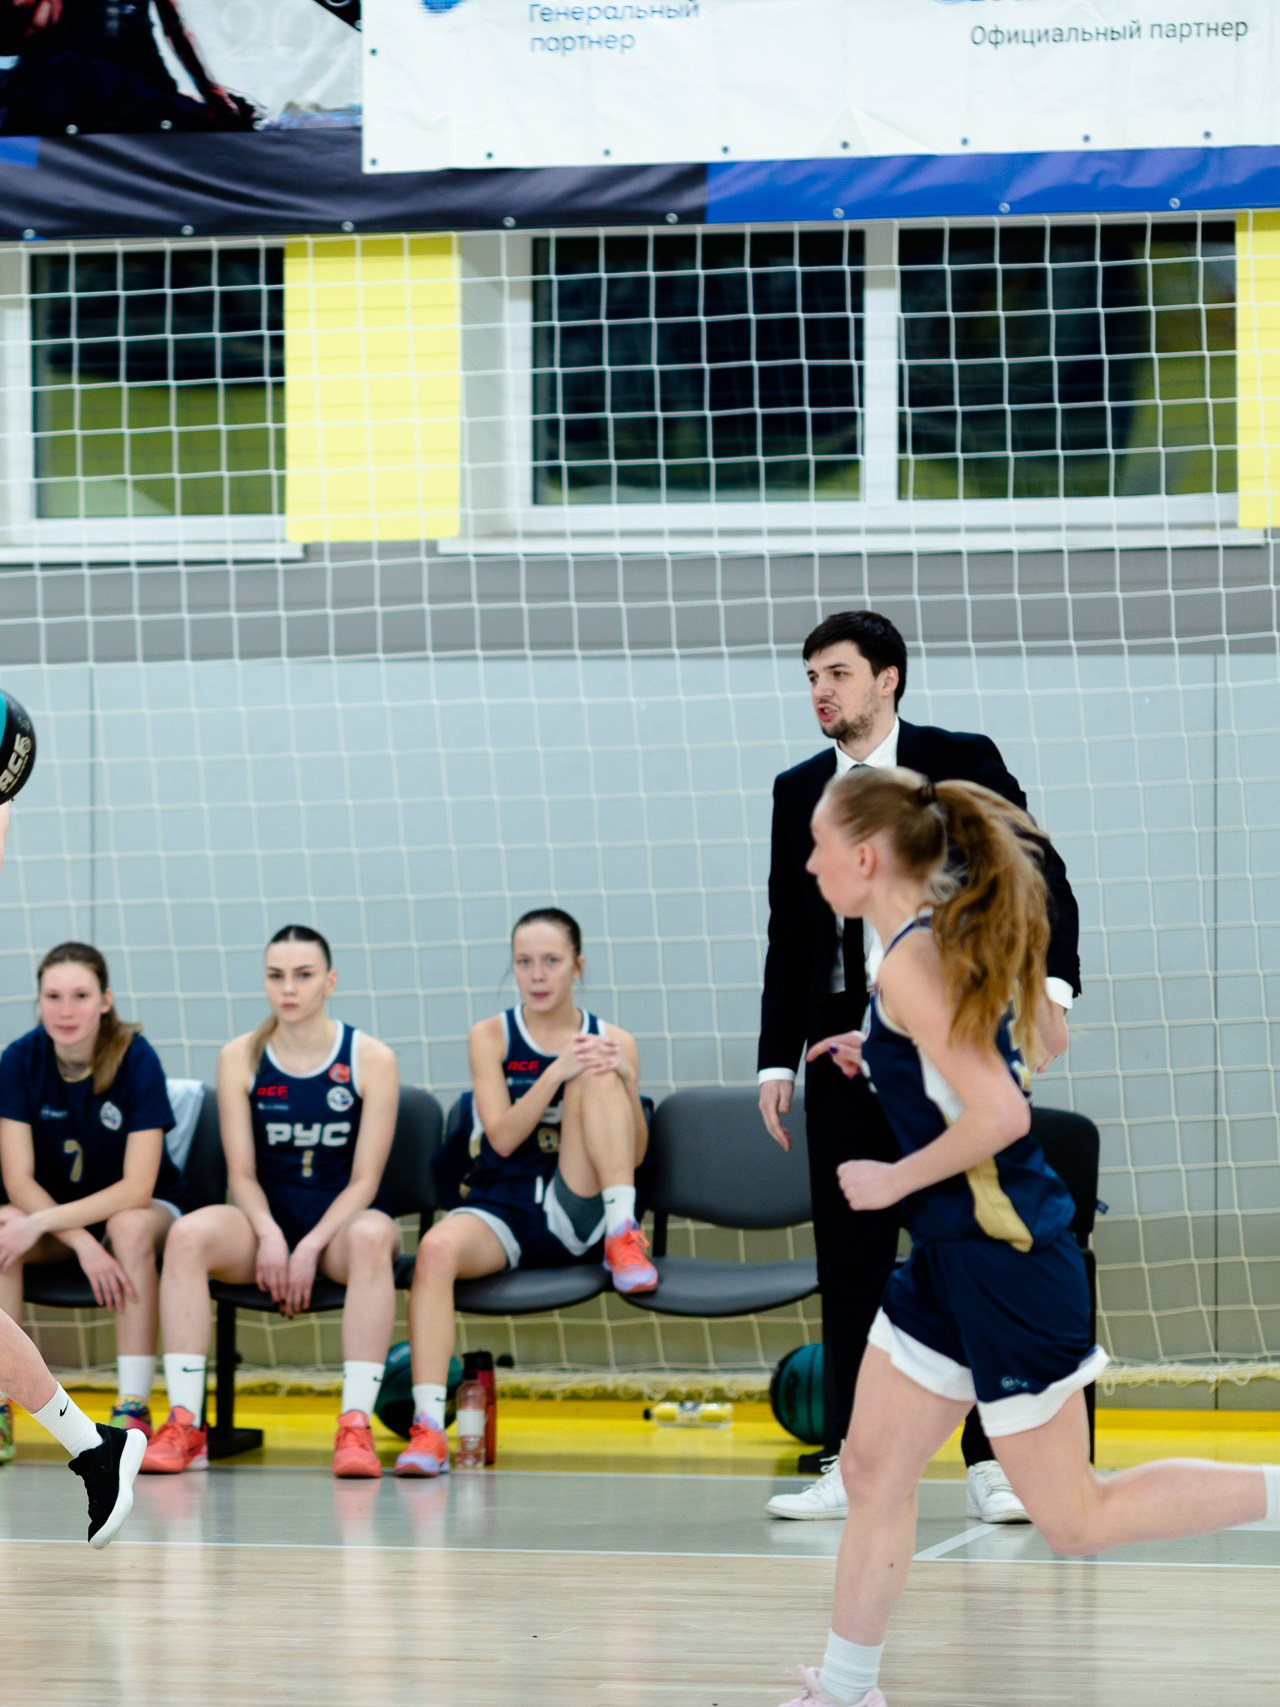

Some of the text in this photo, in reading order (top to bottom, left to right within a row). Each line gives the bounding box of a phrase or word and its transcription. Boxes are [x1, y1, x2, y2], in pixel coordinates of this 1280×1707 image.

[528, 0, 700, 25] Генеральный
[530, 33, 636, 57] партнер
[970, 18, 1249, 49] Официальный партнер
[266, 1121, 352, 1147] РУС
[63, 1139, 83, 1183] 7
